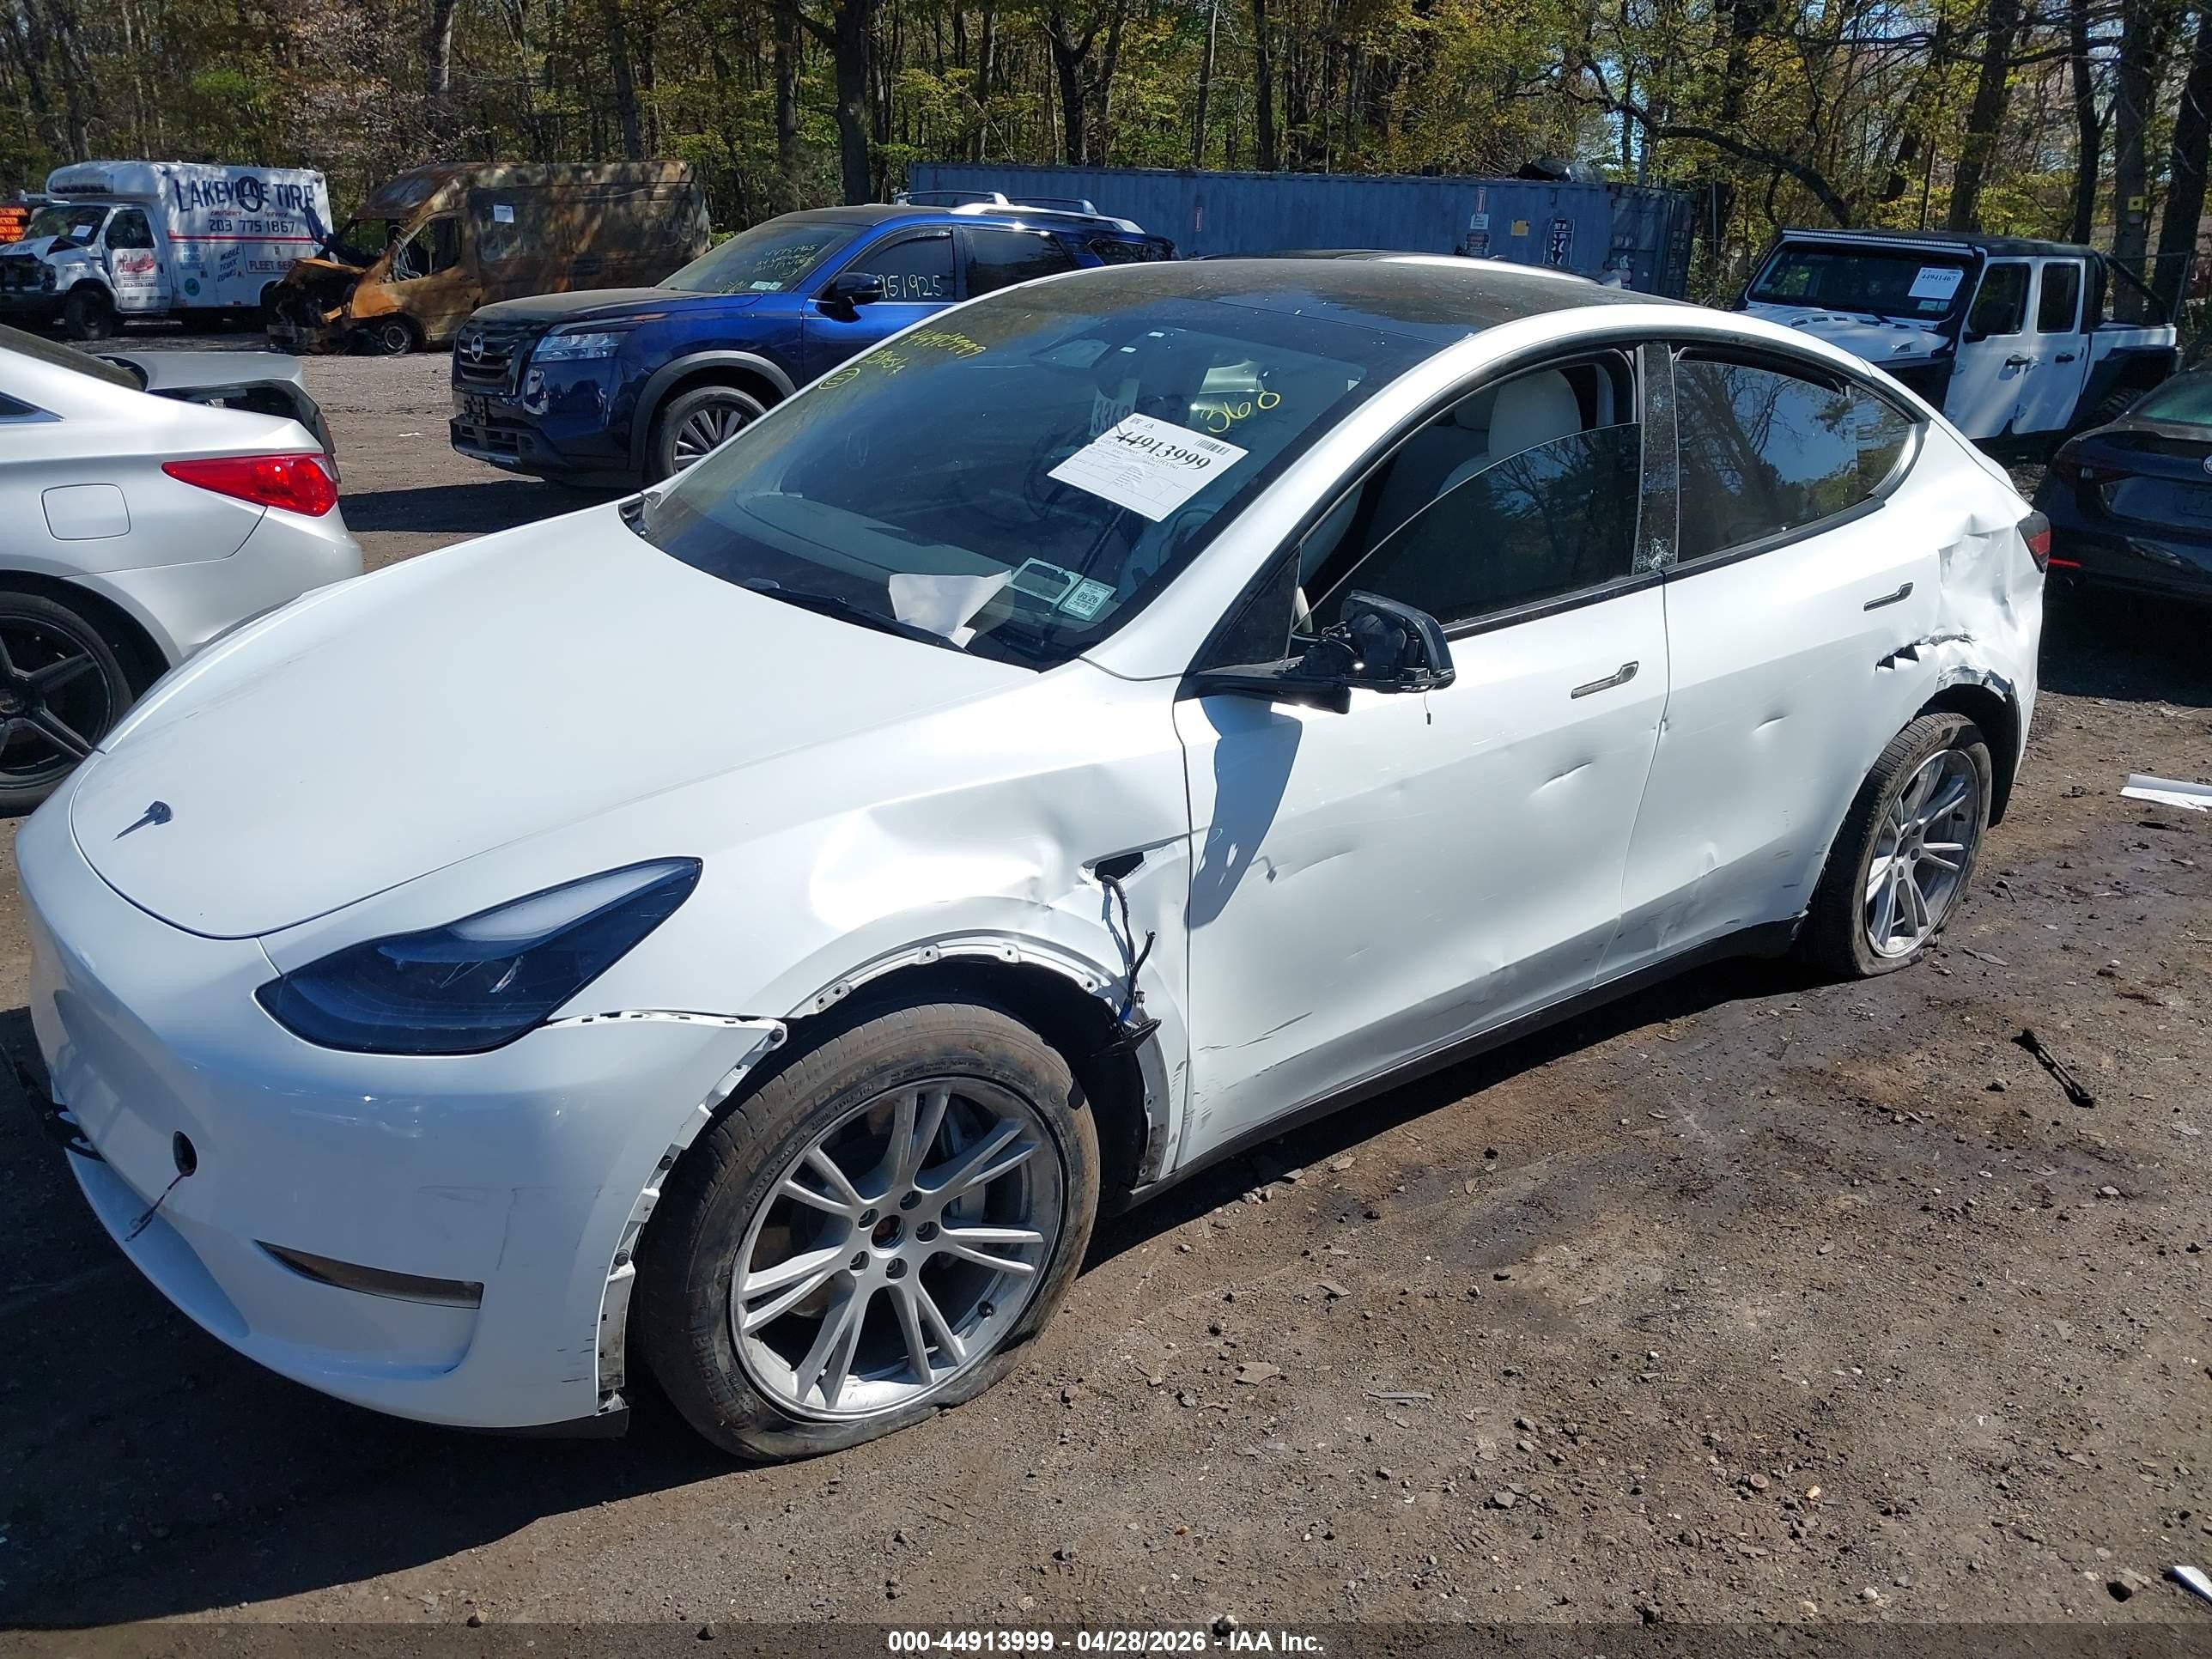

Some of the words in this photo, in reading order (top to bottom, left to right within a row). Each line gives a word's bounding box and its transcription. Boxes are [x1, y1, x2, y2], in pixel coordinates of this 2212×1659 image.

[209, 219, 233, 232] 203
[249, 260, 274, 271] FLEET
[1200, 390, 1281, 434] 360
[1115, 431, 1212, 471] 44913999
